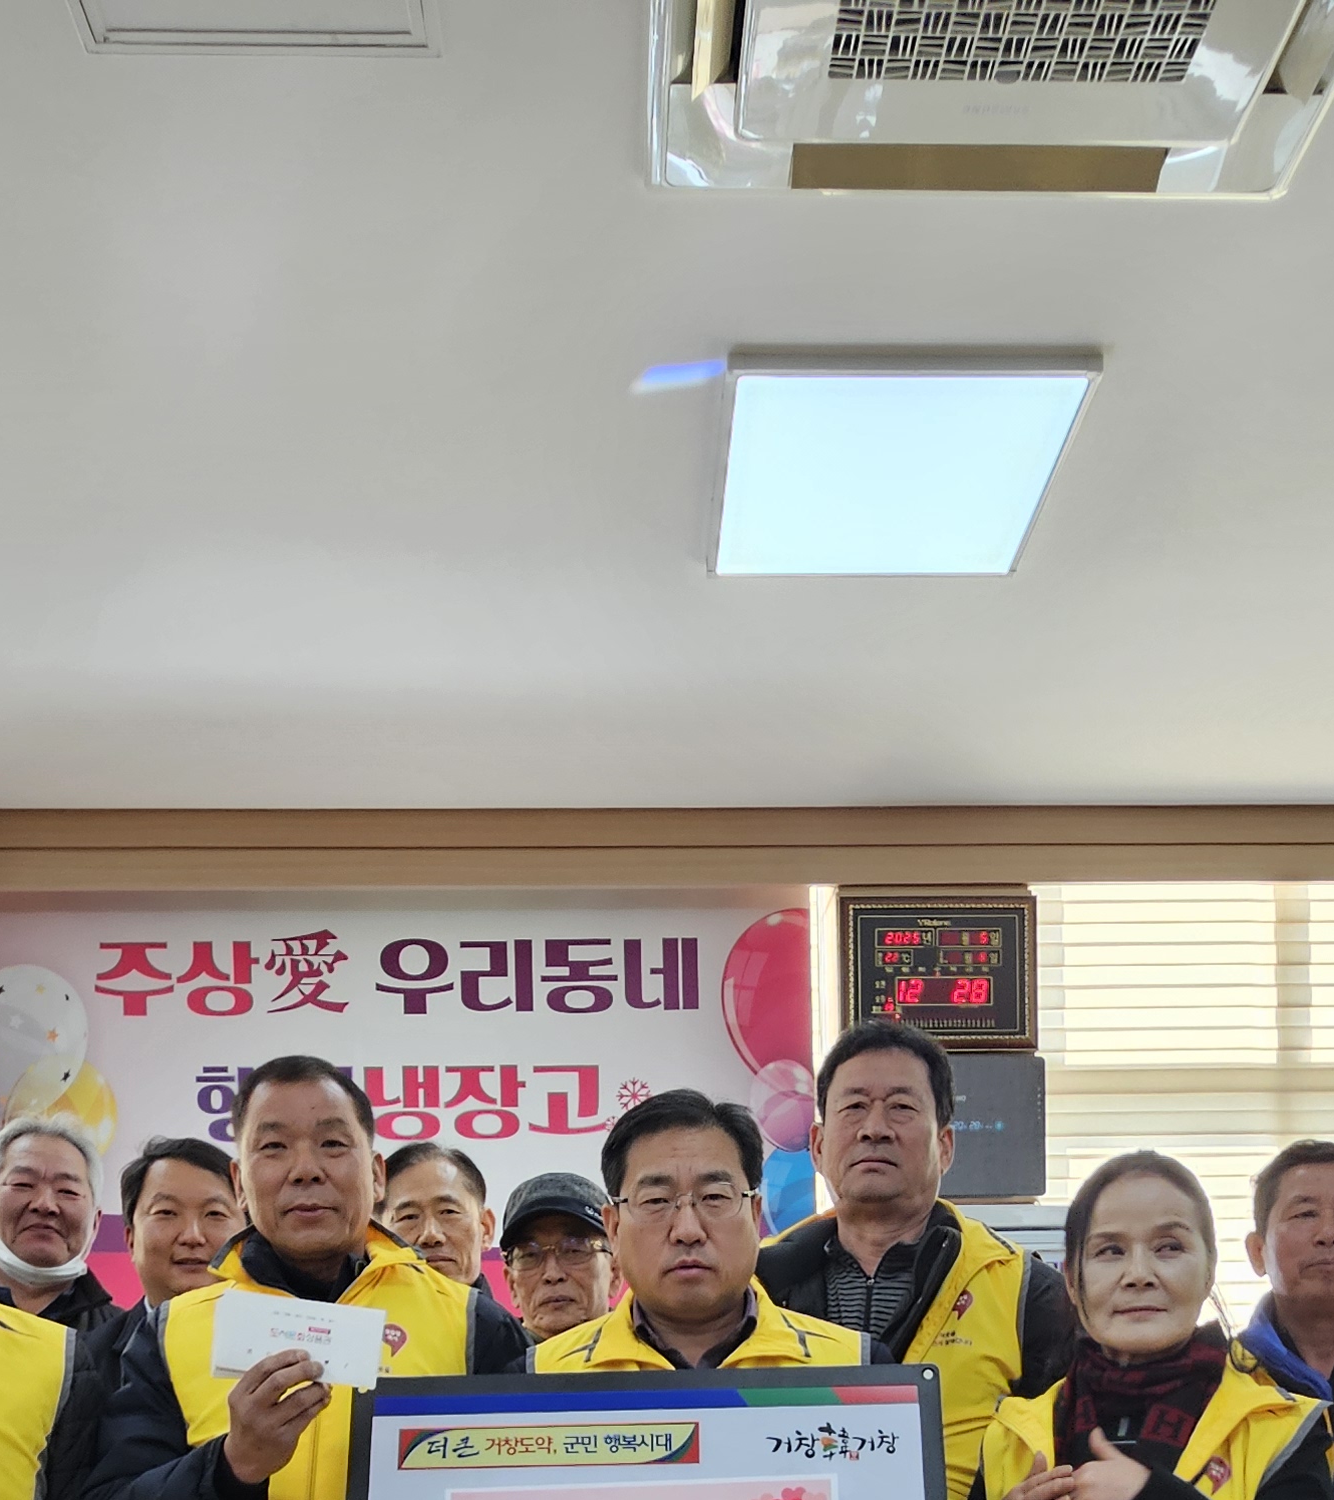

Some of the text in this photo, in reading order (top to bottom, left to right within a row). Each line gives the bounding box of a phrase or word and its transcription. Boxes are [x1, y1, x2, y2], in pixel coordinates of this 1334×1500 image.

[94, 929, 700, 1017] 주상愛 우리동네
[898, 980, 924, 1003] 12
[427, 1433, 673, 1458] 더 큰 거창도약, 군민 행복시대
